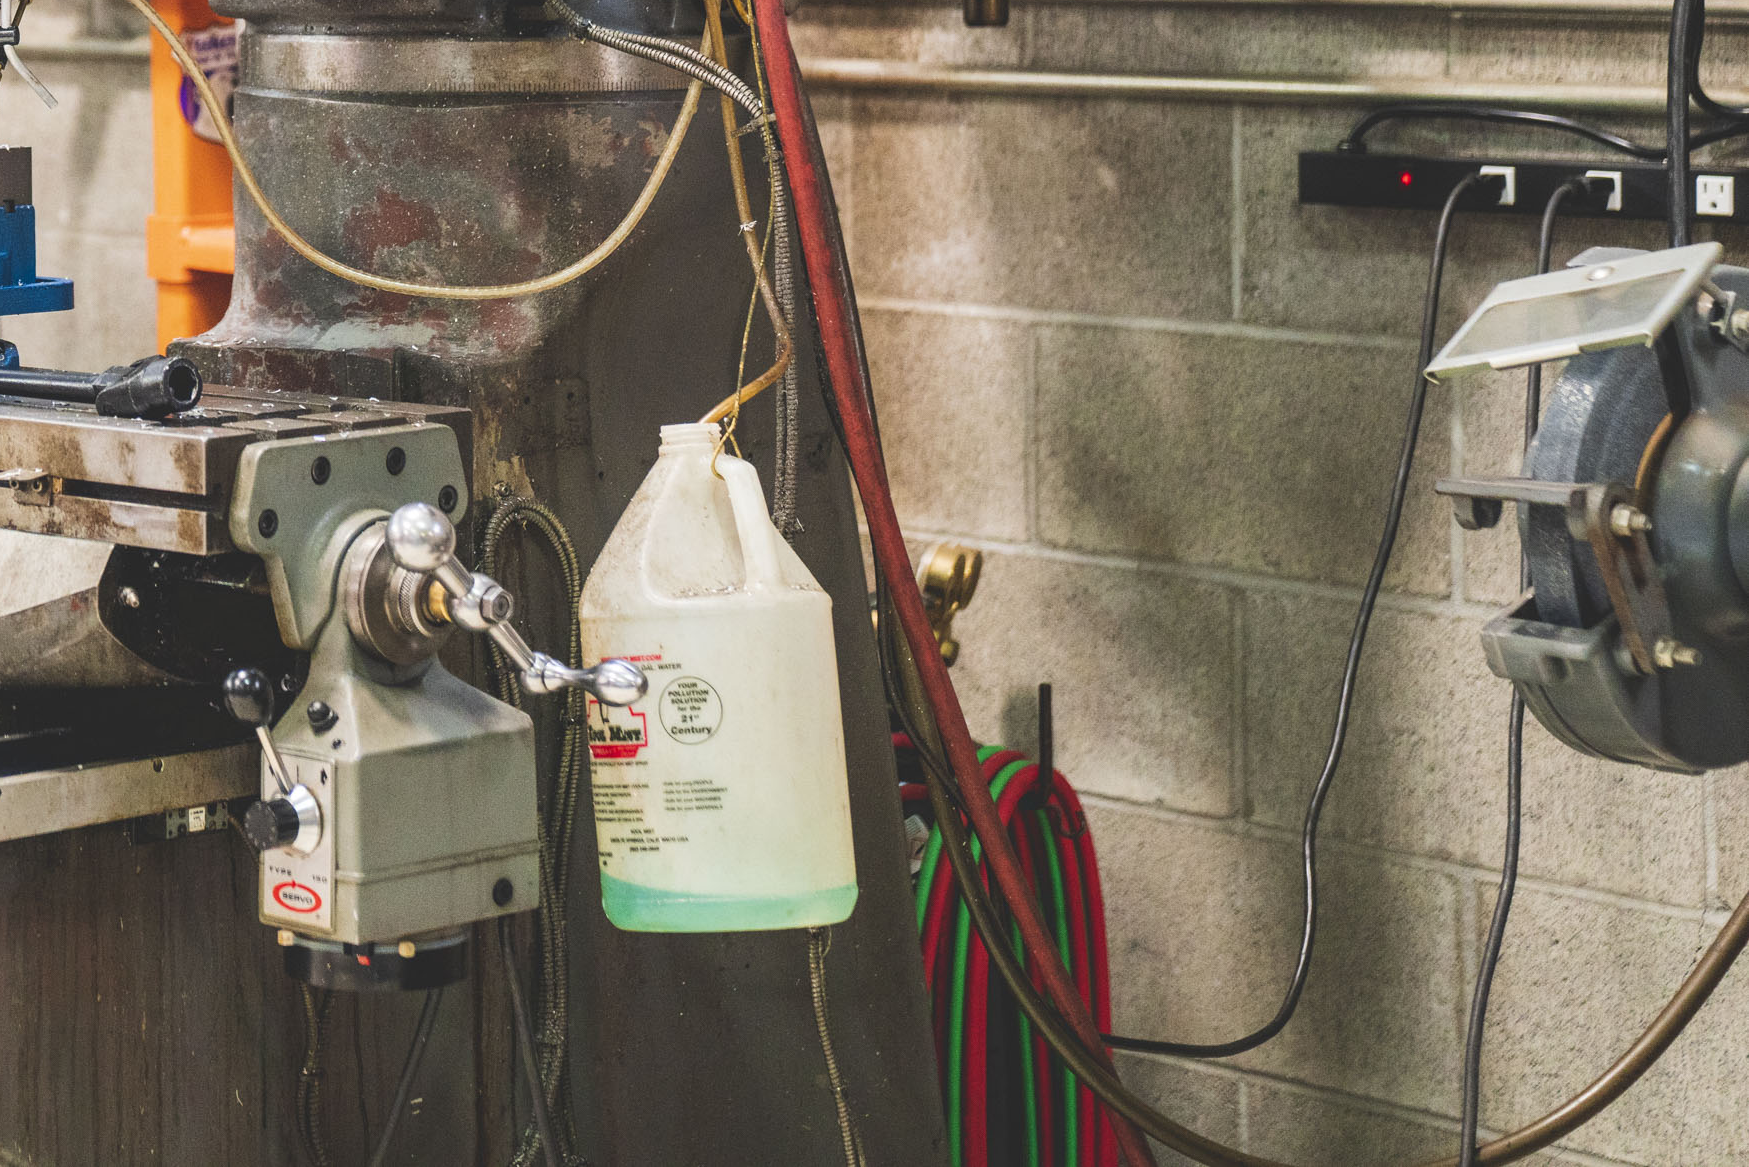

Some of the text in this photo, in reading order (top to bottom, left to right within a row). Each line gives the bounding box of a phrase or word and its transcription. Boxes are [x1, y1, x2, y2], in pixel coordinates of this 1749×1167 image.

[658, 663, 682, 671] WATER
[668, 689, 709, 697] POLLUTION
[671, 725, 712, 735] Century
[282, 891, 313, 904] SERVO
